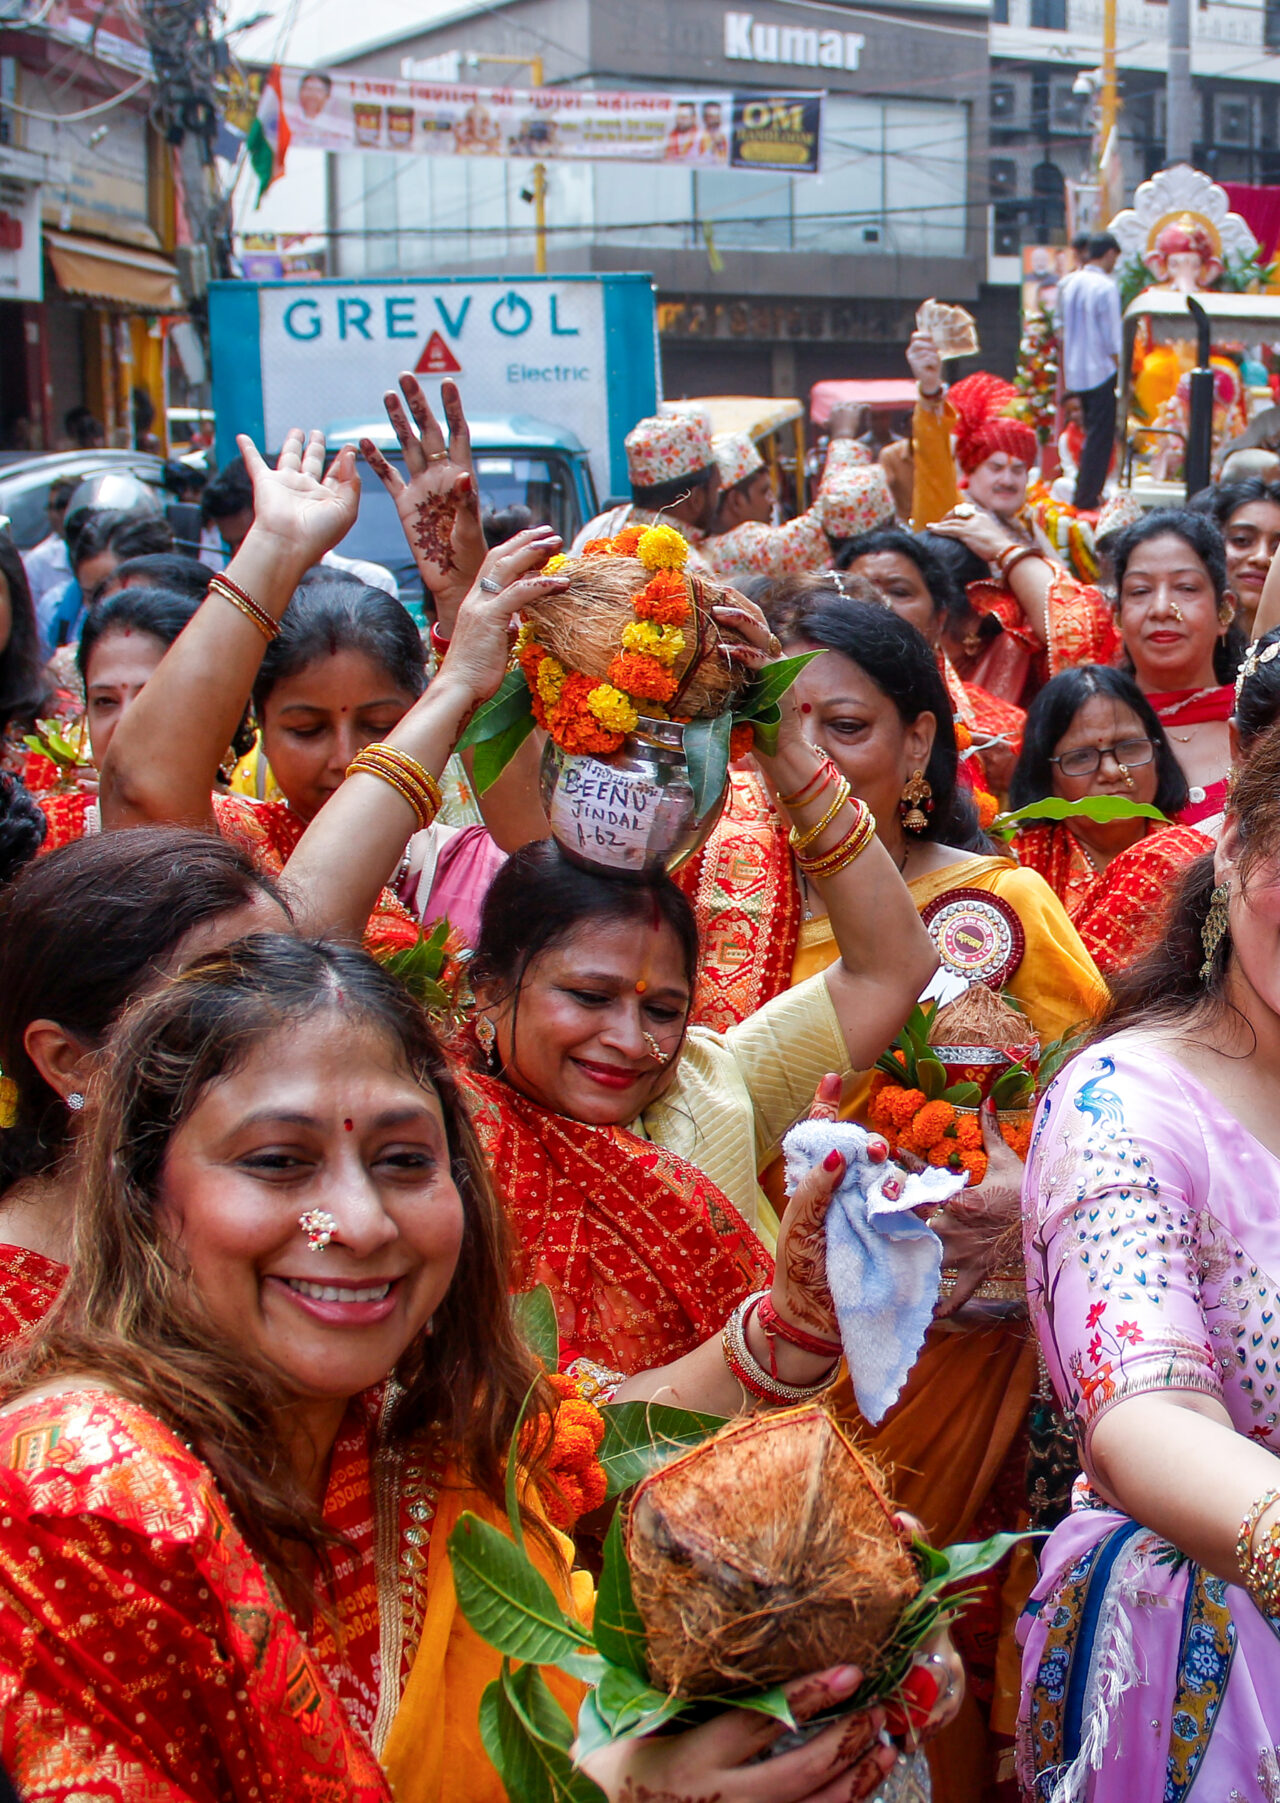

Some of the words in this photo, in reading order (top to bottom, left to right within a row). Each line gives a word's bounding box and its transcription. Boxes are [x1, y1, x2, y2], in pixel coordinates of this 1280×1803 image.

[724, 11, 866, 72] Kumar
[742, 101, 804, 132] OM
[283, 291, 580, 341] GREVOL
[506, 363, 590, 384] Electric
[564, 768, 647, 813] BEENU
[576, 822, 627, 848] A-62
